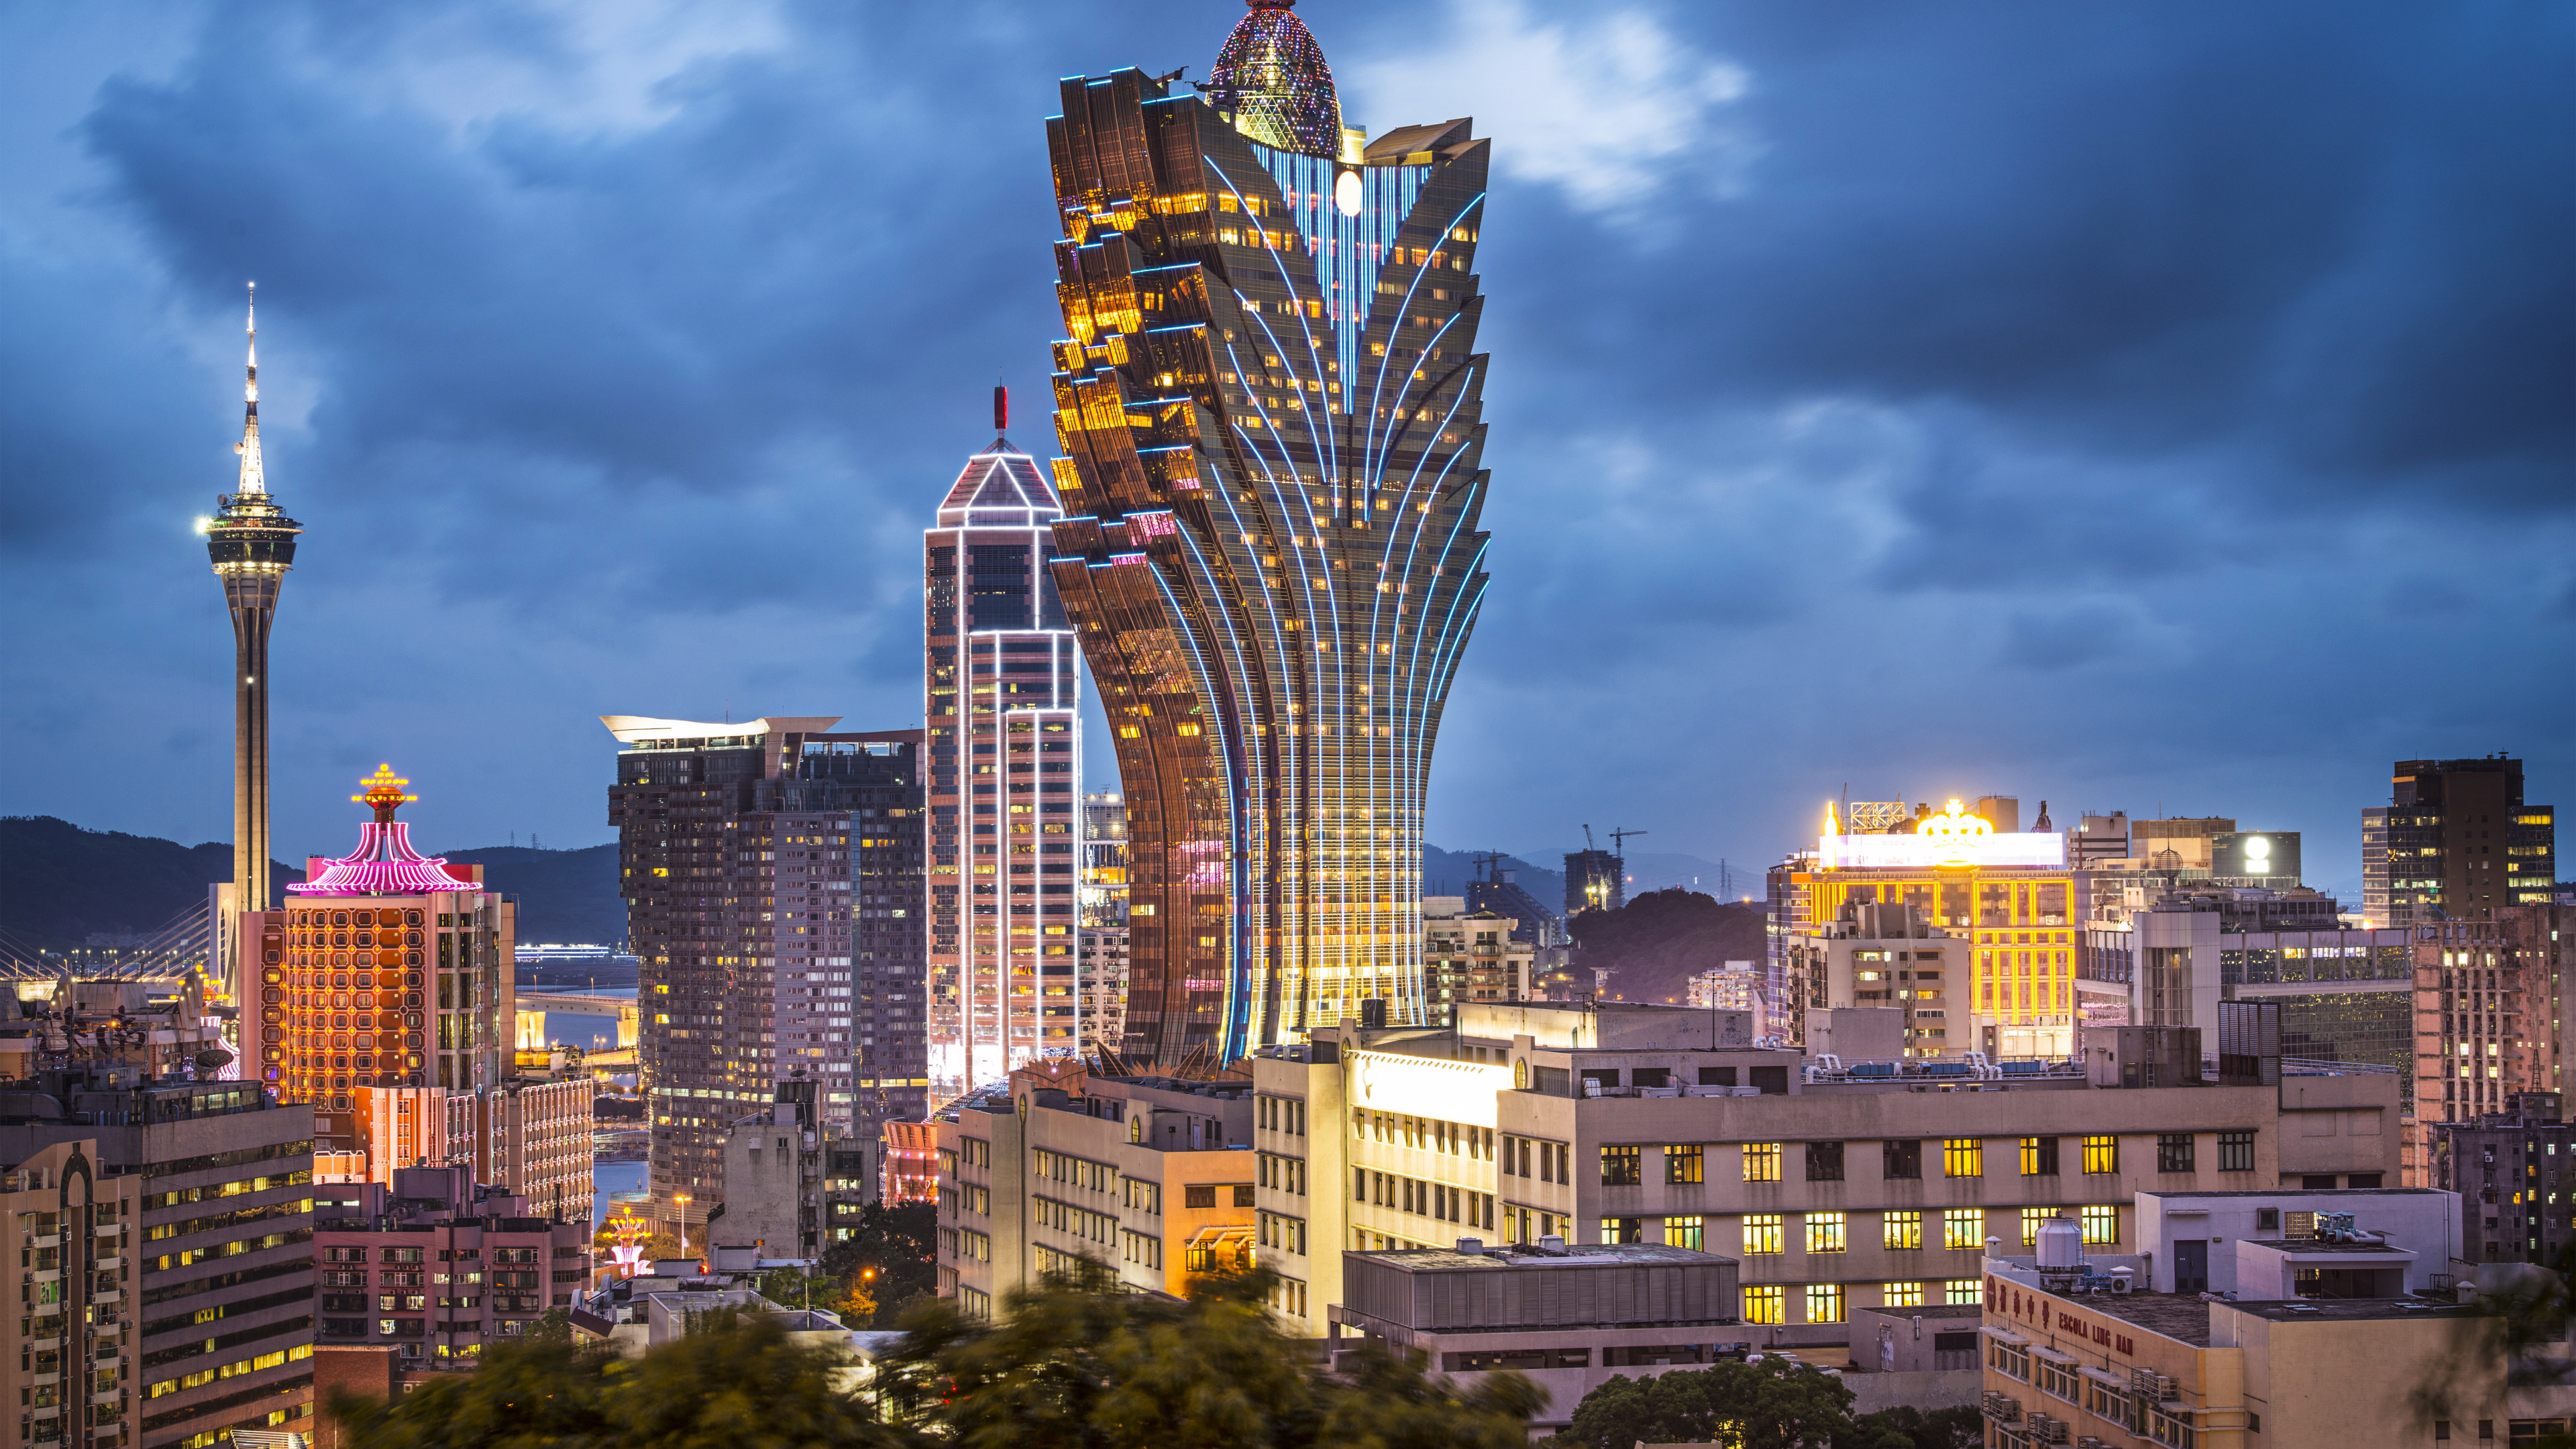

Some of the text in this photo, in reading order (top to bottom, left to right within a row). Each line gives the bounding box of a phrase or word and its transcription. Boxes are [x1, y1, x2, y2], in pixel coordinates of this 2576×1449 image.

[2059, 1311, 2133, 1356] ESCOLA LING NAN
